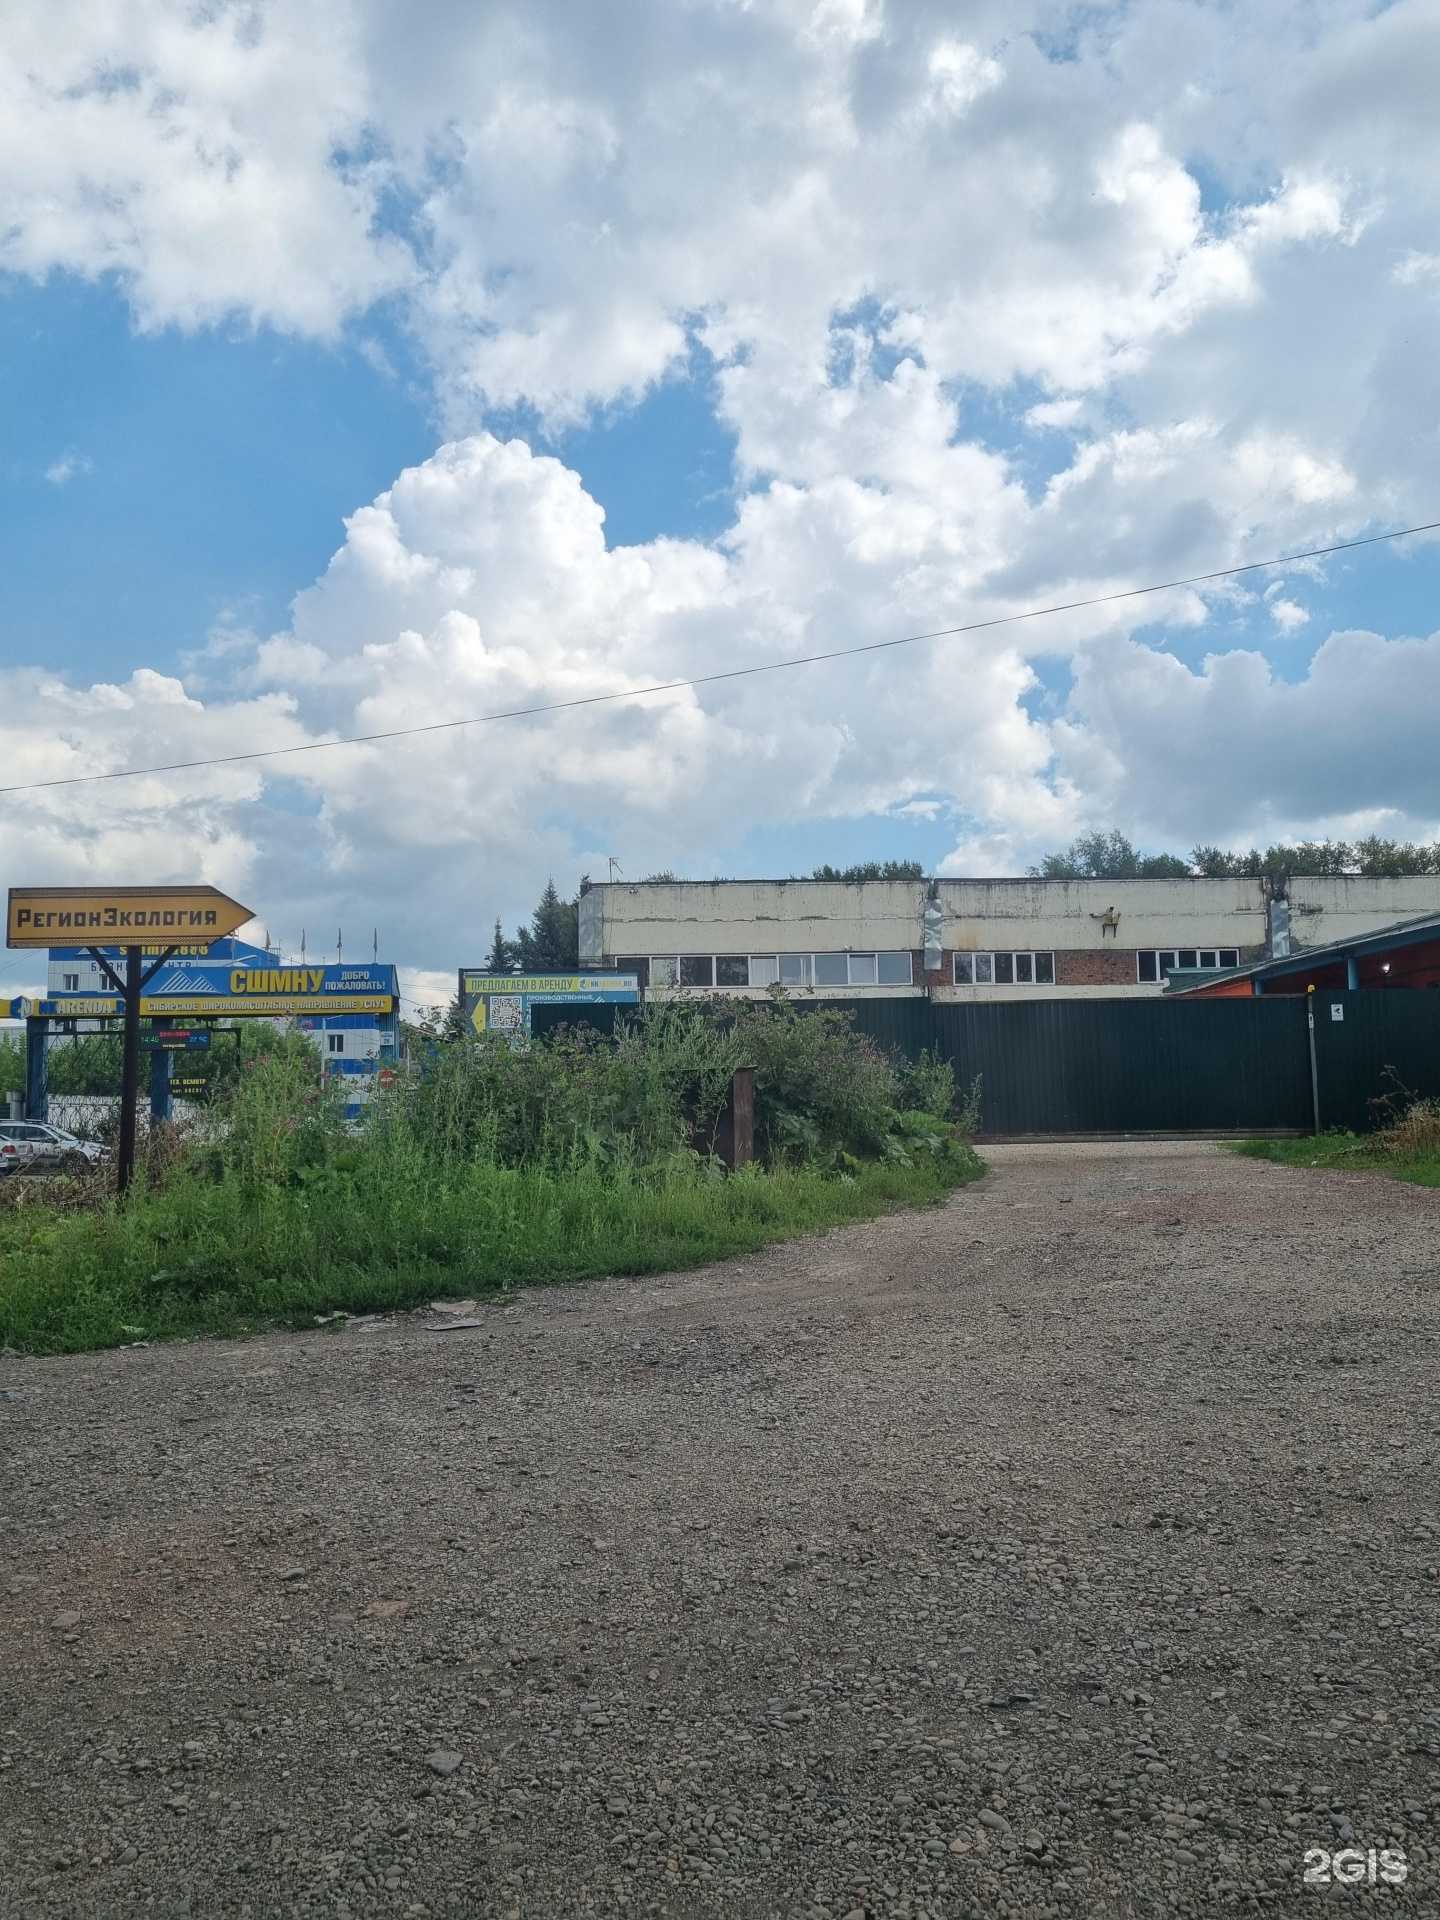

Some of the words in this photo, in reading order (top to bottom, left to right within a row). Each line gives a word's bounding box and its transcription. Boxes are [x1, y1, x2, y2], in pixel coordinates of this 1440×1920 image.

[230, 969, 324, 992] СШМНУ
[341, 971, 370, 981] ДОБРО
[325, 980, 386, 991] ПОЖАЛОВАТЬ!
[471, 978, 529, 991] ПРЕДЛАГАЕМ
[531, 979, 537, 989] В
[538, 978, 573, 990] АРЕНДУ
